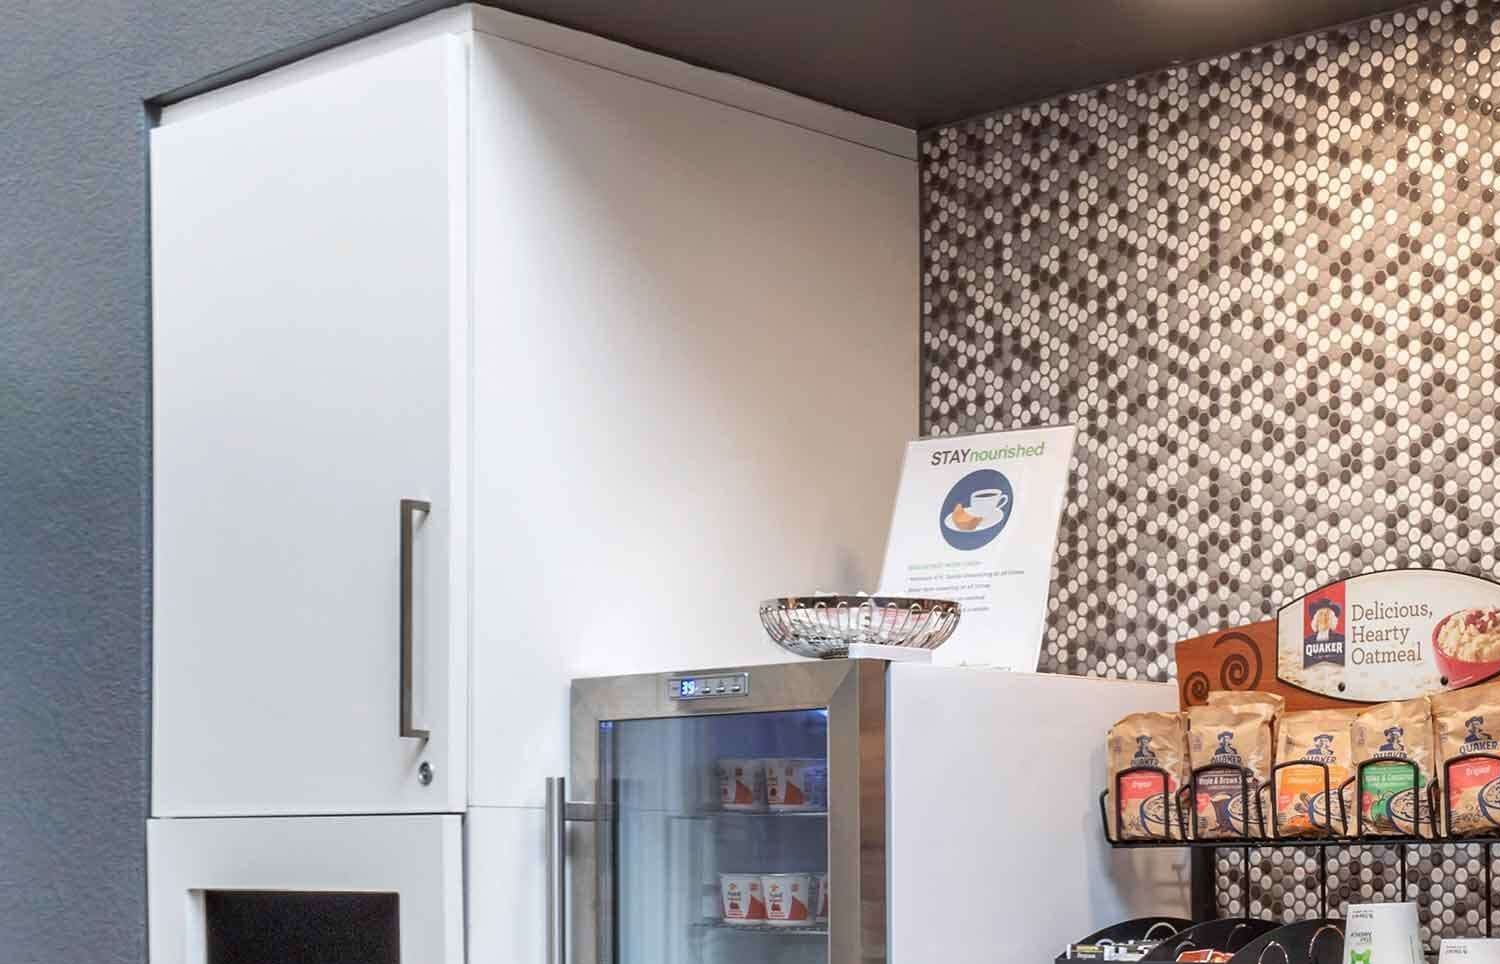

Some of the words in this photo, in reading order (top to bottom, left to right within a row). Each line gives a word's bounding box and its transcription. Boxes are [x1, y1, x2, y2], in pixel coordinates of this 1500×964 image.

[1351, 601, 1433, 622] Delicious,
[1351, 625, 1411, 645] Hearty
[1305, 641, 1343, 656] QUAKER
[1351, 642, 1423, 665] Oatmeal
[1459, 740, 1499, 754] QUAKER
